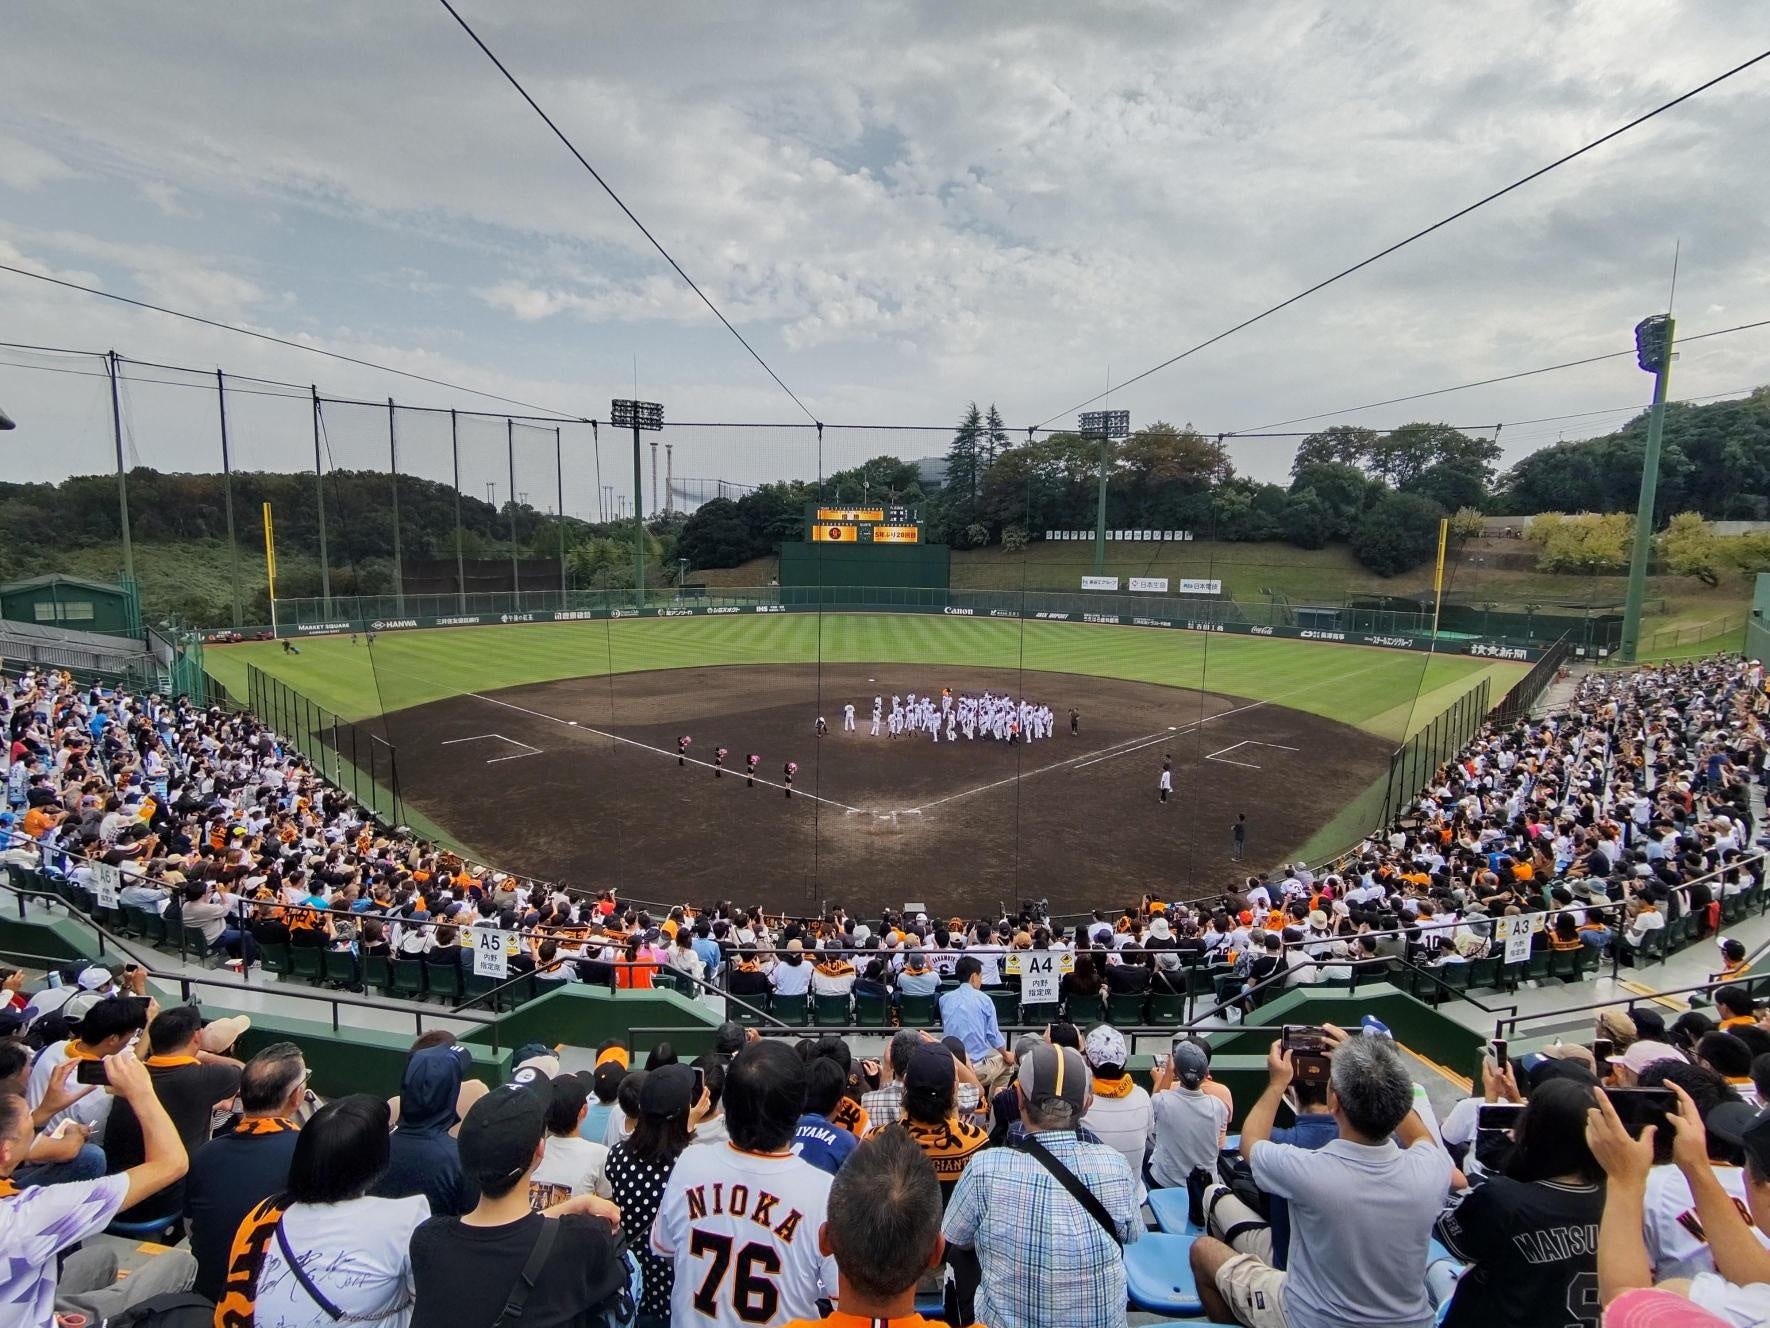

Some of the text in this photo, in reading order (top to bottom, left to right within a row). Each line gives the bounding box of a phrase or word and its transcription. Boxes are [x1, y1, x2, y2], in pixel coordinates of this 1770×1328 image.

[1140, 581, 1166, 589] 日本生命
[944, 606, 974, 615] Canon
[325, 622, 350, 630] SQUARE
[387, 620, 417, 628] HANWA
[1512, 919, 1529, 935] A3
[480, 933, 500, 951] A5
[483, 953, 498, 962] 内野
[1029, 957, 1053, 973] A4
[1032, 979, 1048, 987] 内野
[1029, 988, 1052, 997] 指定席
[796, 1126, 837, 1146] IYAMA
[685, 1182, 805, 1246] NIOKA
[1512, 1224, 1599, 1264] MATSU
[689, 1226, 782, 1326] 76
